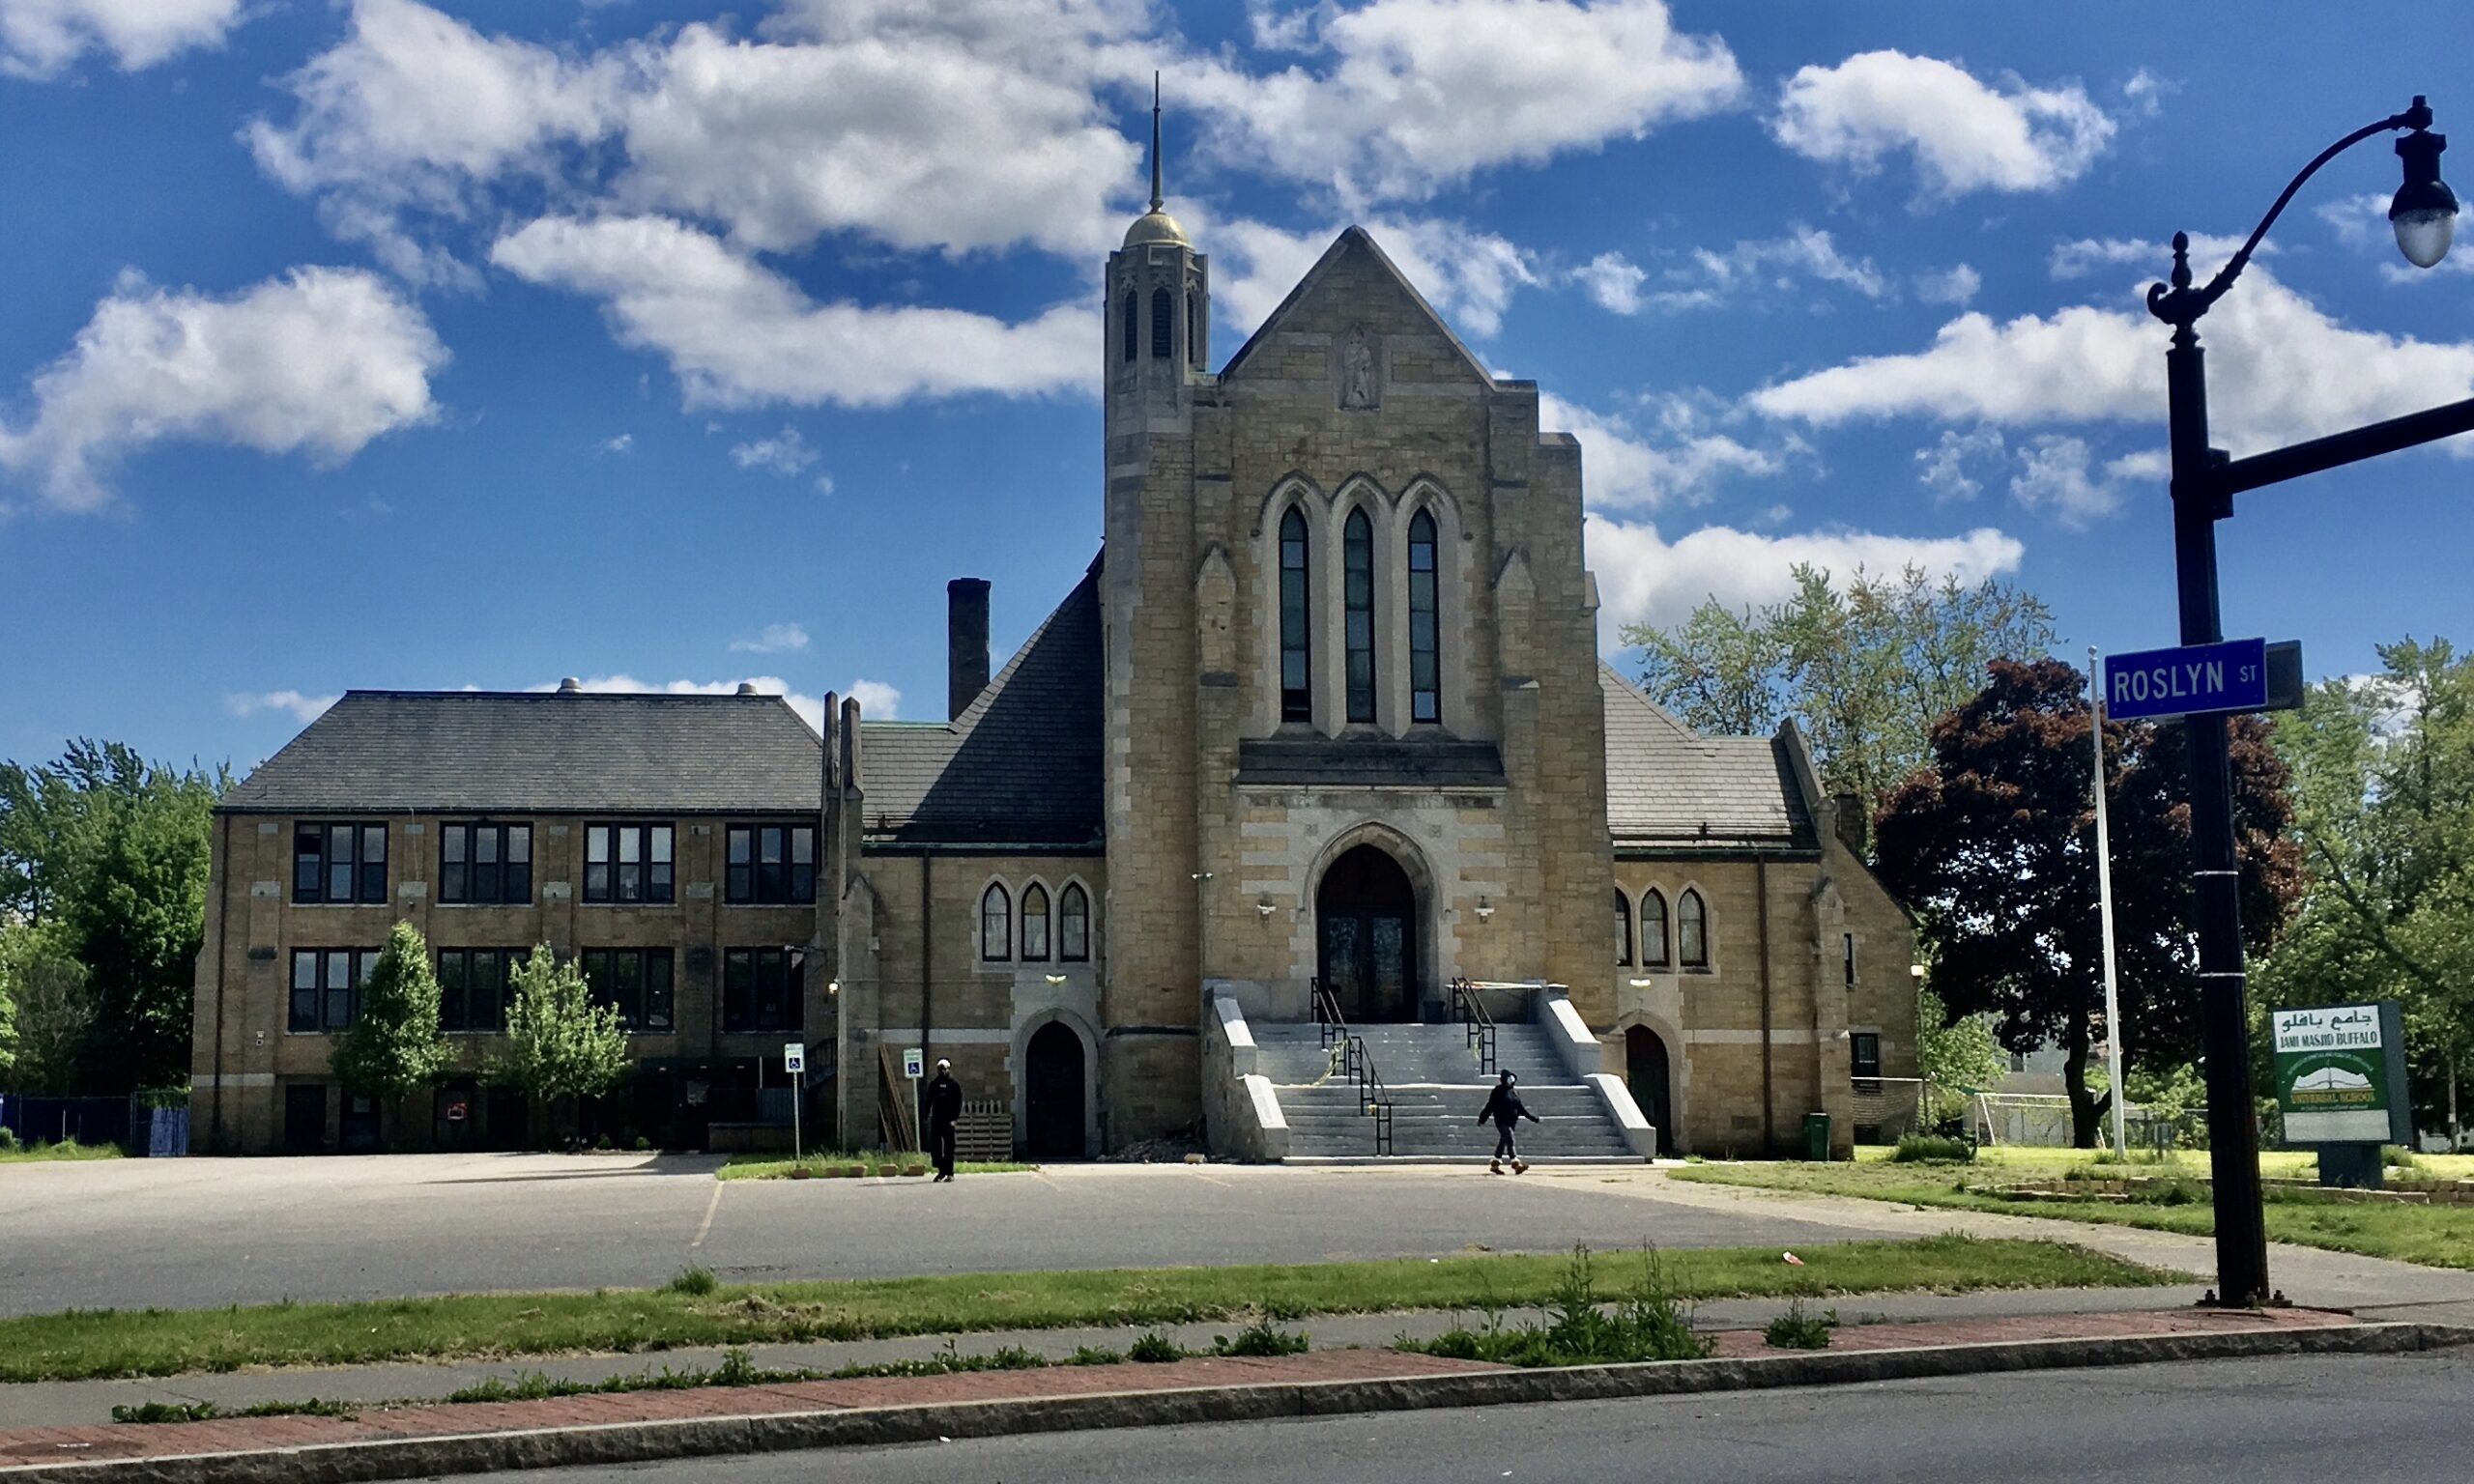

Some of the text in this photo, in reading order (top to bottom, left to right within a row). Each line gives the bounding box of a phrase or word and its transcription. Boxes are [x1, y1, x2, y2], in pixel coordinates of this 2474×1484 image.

[2114, 661, 2258, 703] ROSLYN ST
[2330, 1010, 2373, 1031] جامع
[2301, 1033, 2334, 1047] MASJID
[2336, 1030, 2377, 1045] BUFFALO
